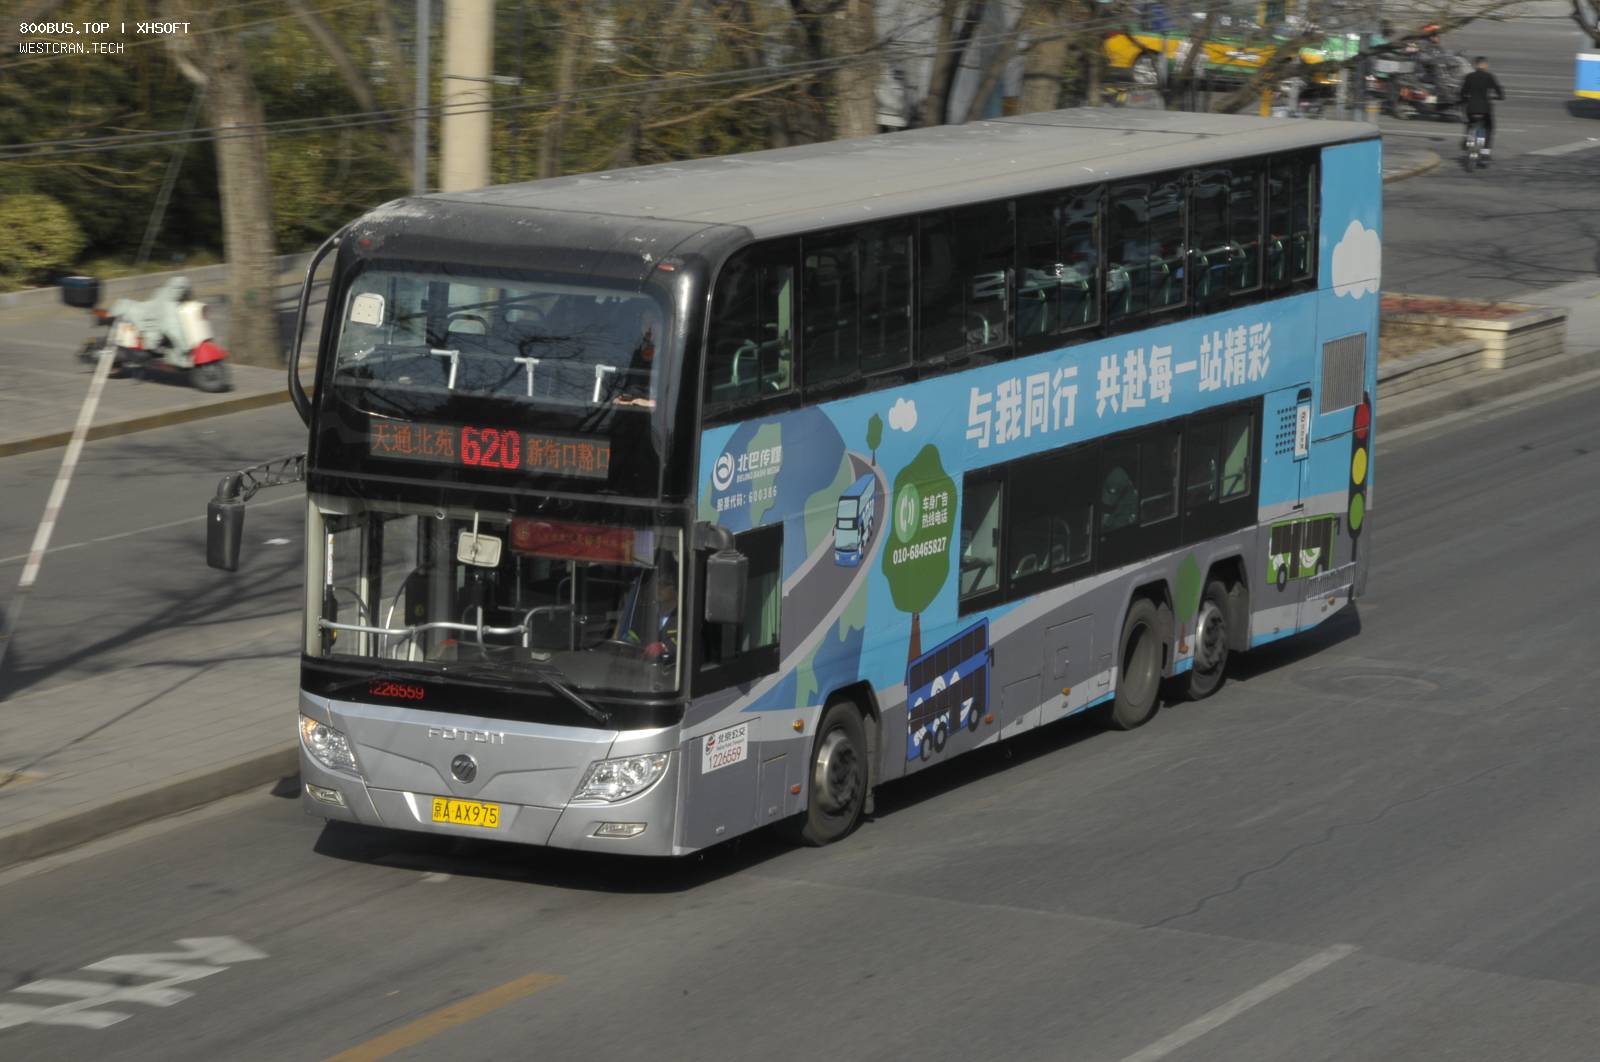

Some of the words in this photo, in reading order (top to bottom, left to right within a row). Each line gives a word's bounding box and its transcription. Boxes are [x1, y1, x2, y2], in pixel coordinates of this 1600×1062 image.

[966, 366, 1078, 449] 与我同行
[1096, 321, 1272, 419] 共赴每一站精彩
[371, 423, 455, 457] 天通北苑
[461, 426, 521, 470] 620
[737, 445, 782, 474] 北巴传媒
[922, 491, 948, 512] 车身广告
[922, 508, 948, 529] 热线电话
[892, 536, 947, 565] 010-68465827
[428, 728, 505, 745] FOTON
[709, 746, 742, 769] 1226559
[433, 802, 450, 818] 京A
[454, 805, 497, 824] AX975
